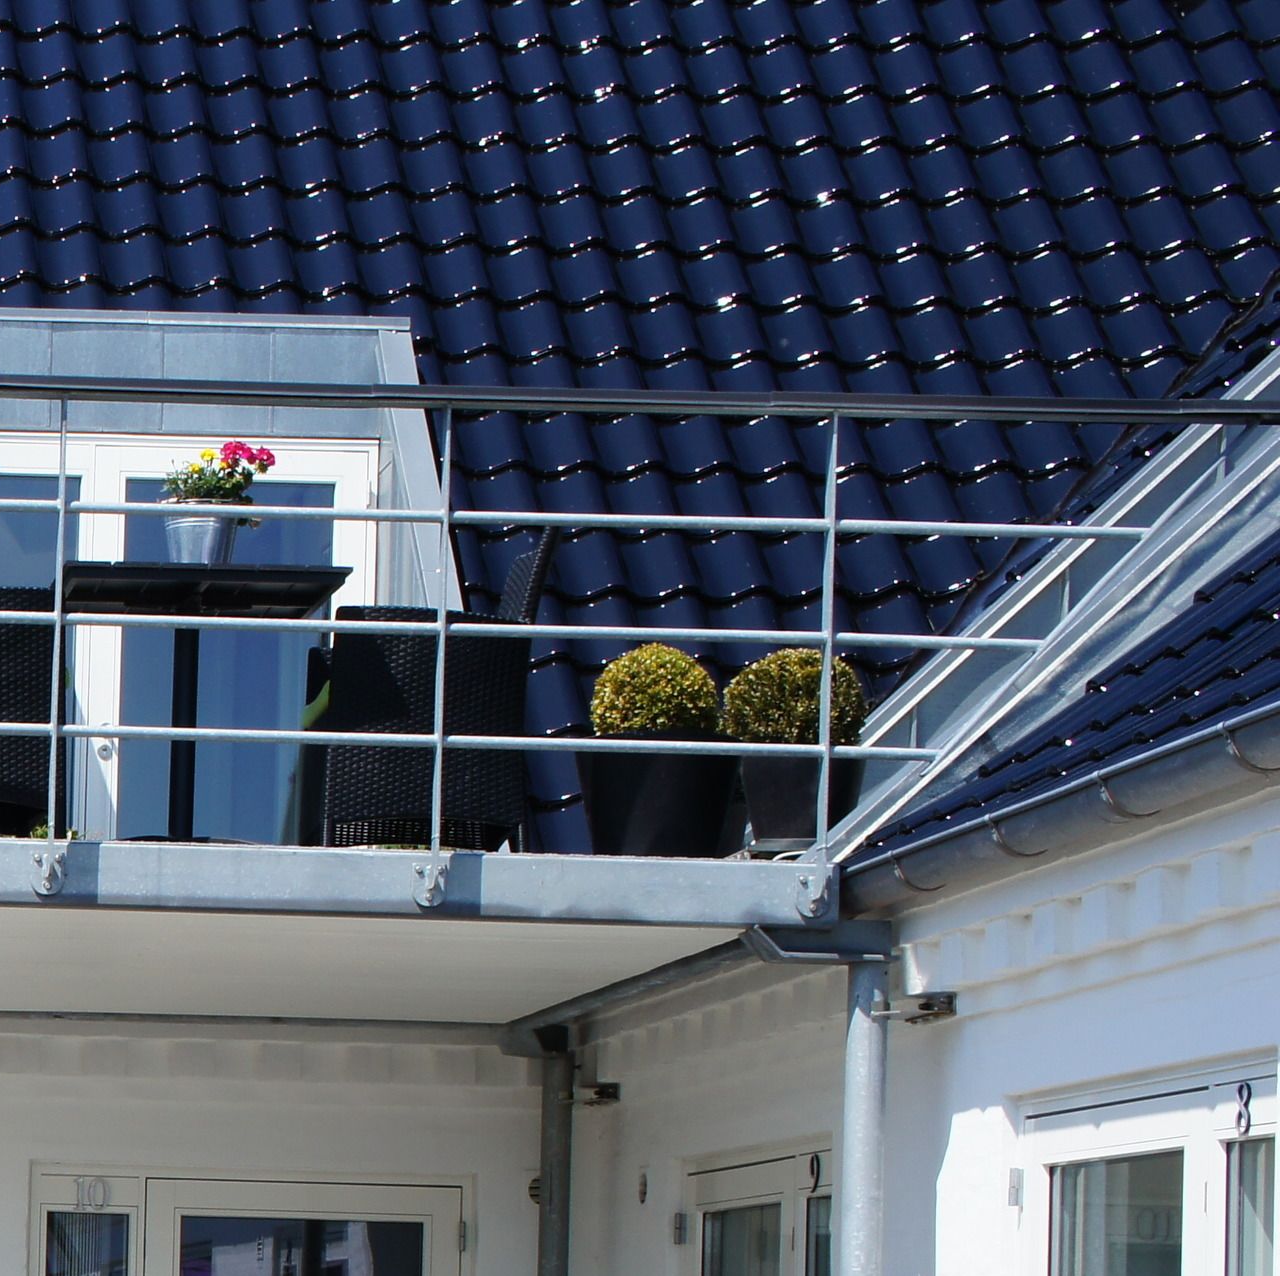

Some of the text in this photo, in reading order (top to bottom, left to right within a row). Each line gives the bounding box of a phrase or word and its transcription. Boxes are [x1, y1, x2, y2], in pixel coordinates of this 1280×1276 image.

[1235, 1081, 1252, 1138] 8
[810, 1153, 820, 1193] 9
[73, 1177, 112, 1211] 10
